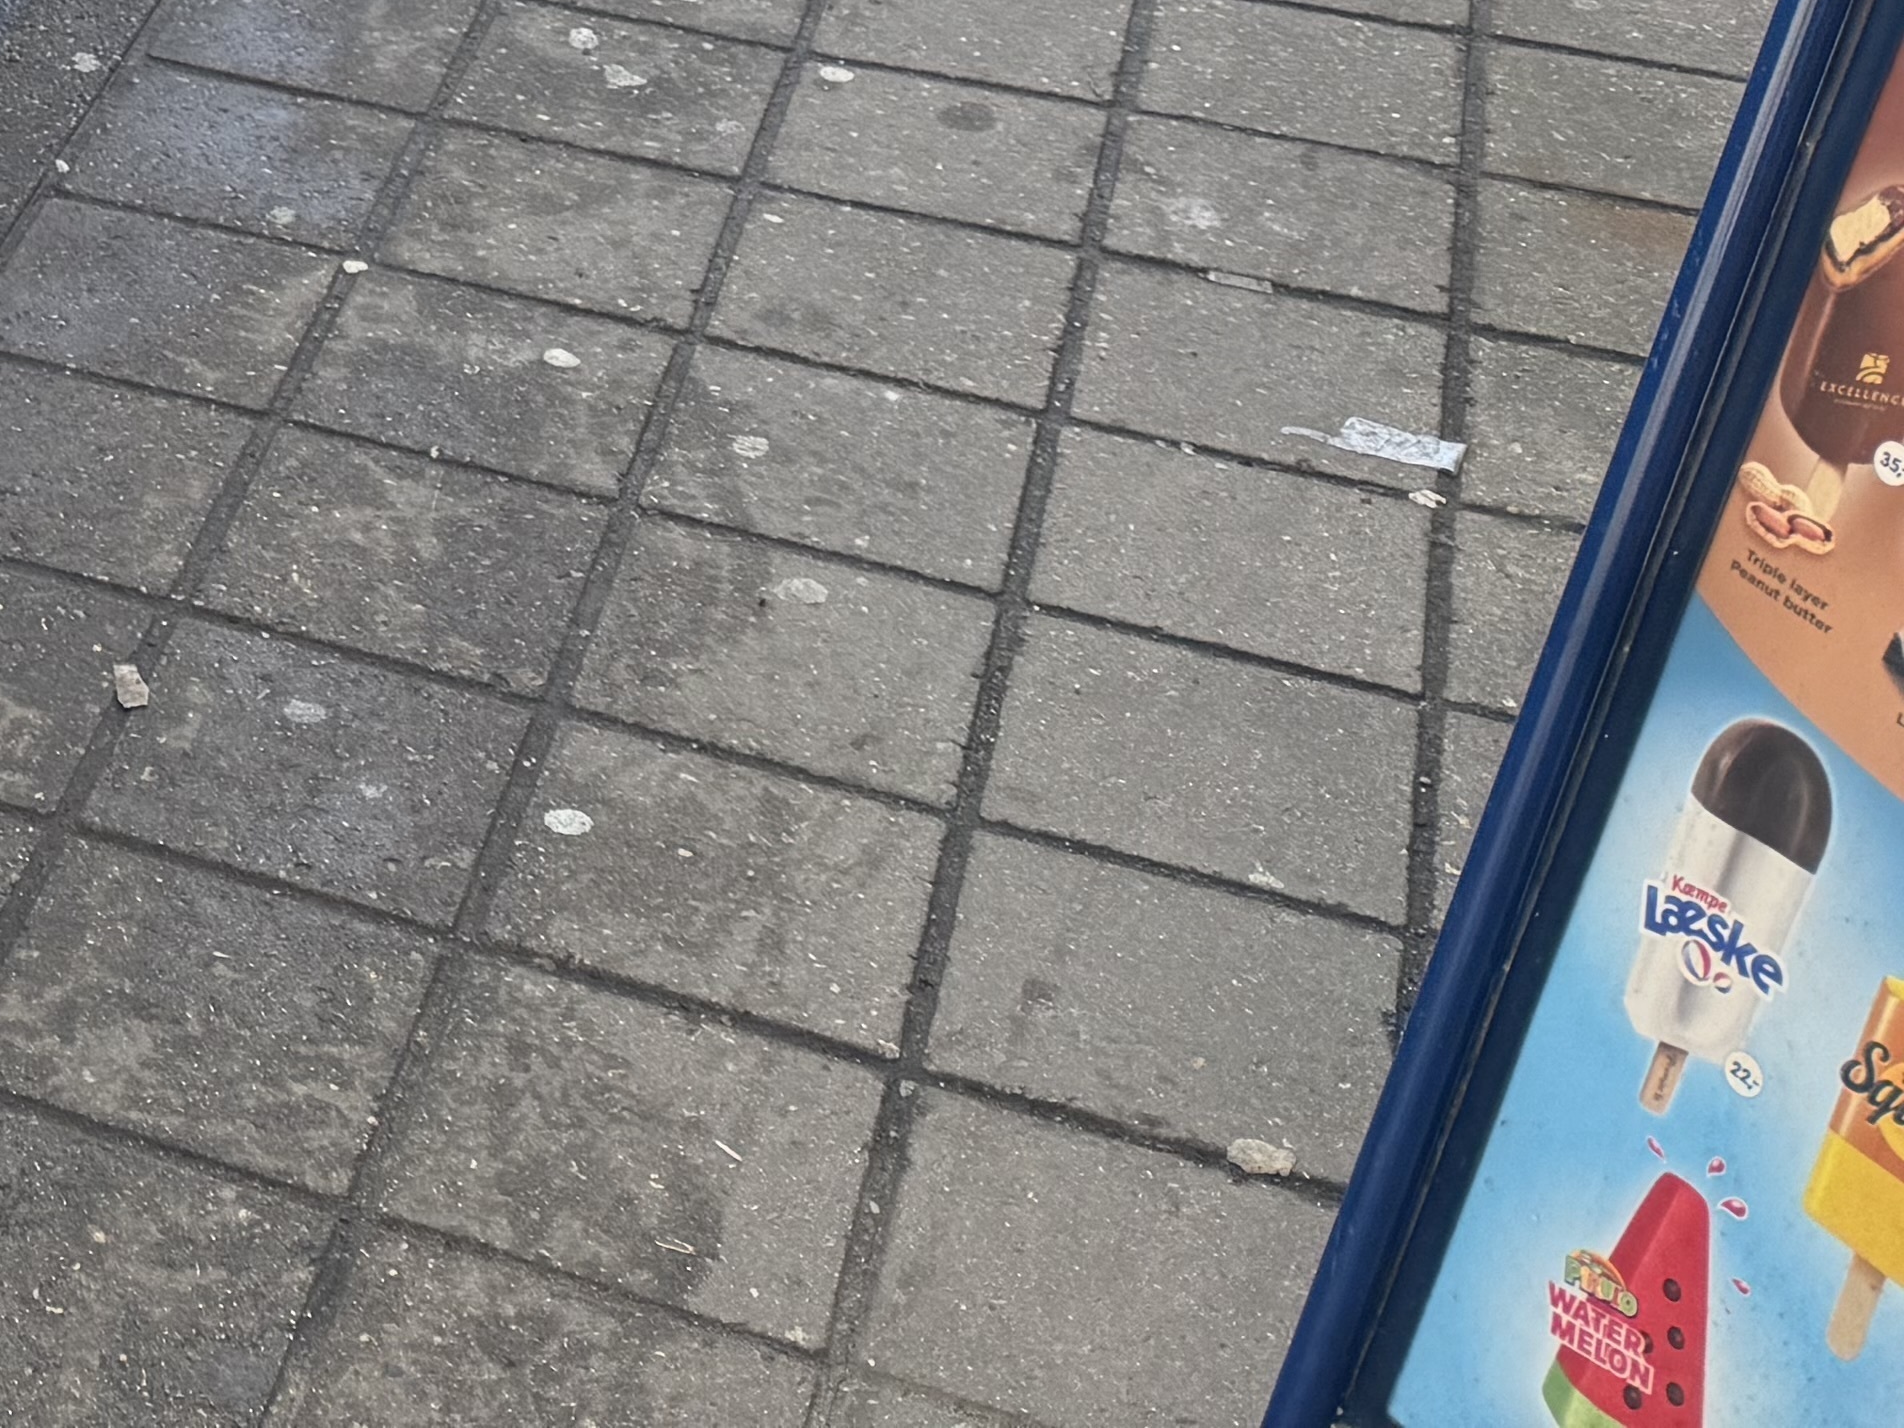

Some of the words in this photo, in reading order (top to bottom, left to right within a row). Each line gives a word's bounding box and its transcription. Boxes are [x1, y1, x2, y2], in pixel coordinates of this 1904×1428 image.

[1879, 450, 1904, 479] 35,
[1730, 559, 1781, 602] Peanut
[1782, 596, 1833, 636] butter
[1745, 549, 1787, 585] Triple
[1789, 577, 1829, 613] layer
[1671, 874, 1728, 913] Kæmpe
[1643, 884, 1784, 995] Læske
[1729, 1059, 1760, 1091] 22,-
[1548, 1279, 1645, 1356] WATER
[1550, 1310, 1652, 1392] MELON
